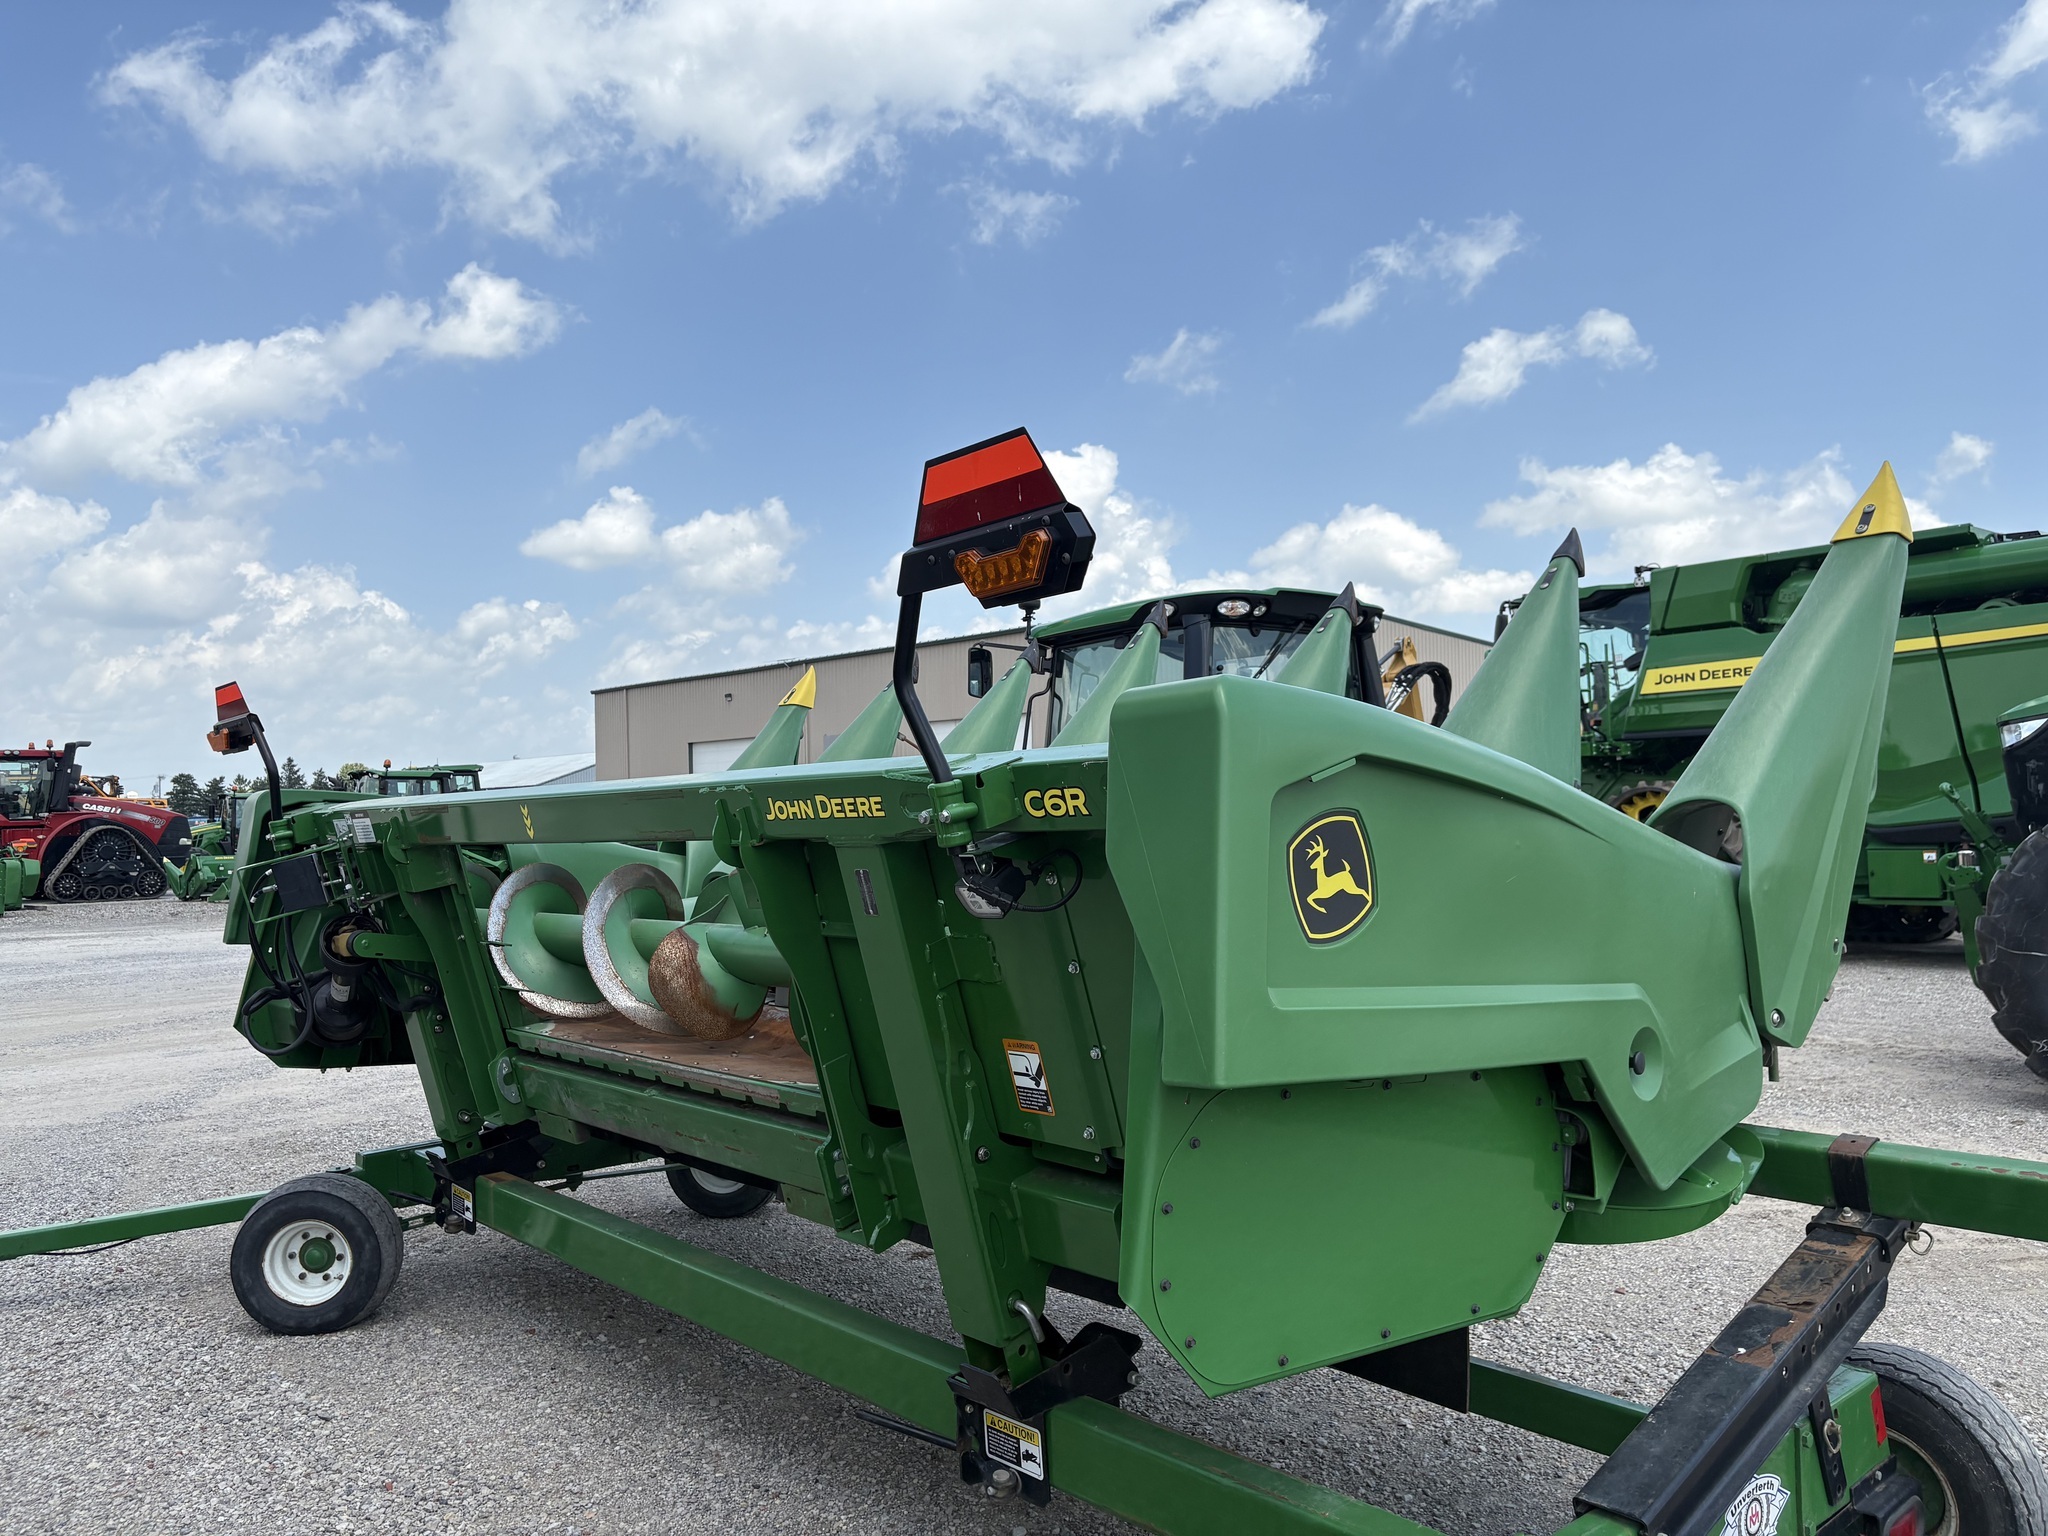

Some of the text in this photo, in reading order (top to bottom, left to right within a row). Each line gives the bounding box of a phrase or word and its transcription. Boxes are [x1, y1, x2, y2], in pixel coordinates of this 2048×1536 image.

[1654, 666, 1753, 685] JOHN DEERE
[82, 803, 111, 813] CASE
[766, 795, 886, 820] JOHN DEERE
[1024, 788, 1090, 818] C6R
[997, 1420, 1036, 1443] CAUTION!
[1730, 1480, 1775, 1518] Unverferth
